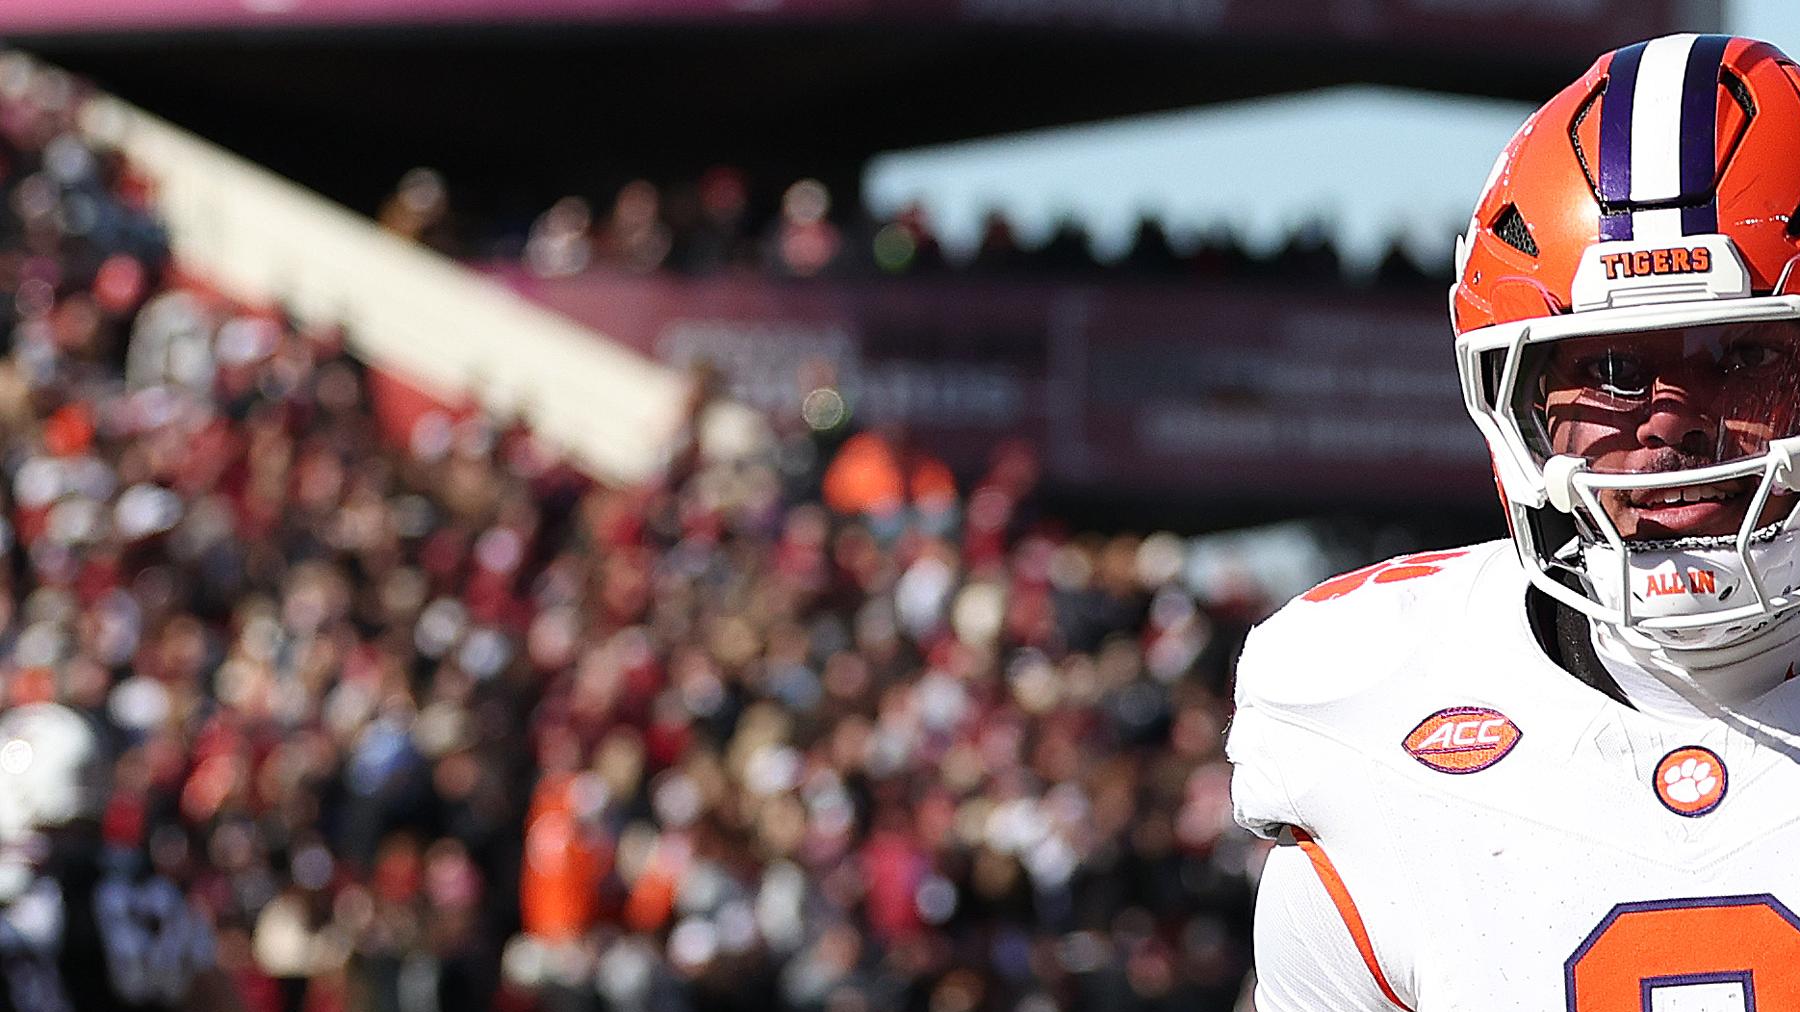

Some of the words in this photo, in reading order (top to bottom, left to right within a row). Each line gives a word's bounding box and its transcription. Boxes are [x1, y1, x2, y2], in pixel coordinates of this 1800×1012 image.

[1600, 247, 1711, 279] TIGERS
[1646, 571, 1687, 597] ALL
[1688, 570, 1716, 594] IN
[1418, 719, 1505, 749] ACC
